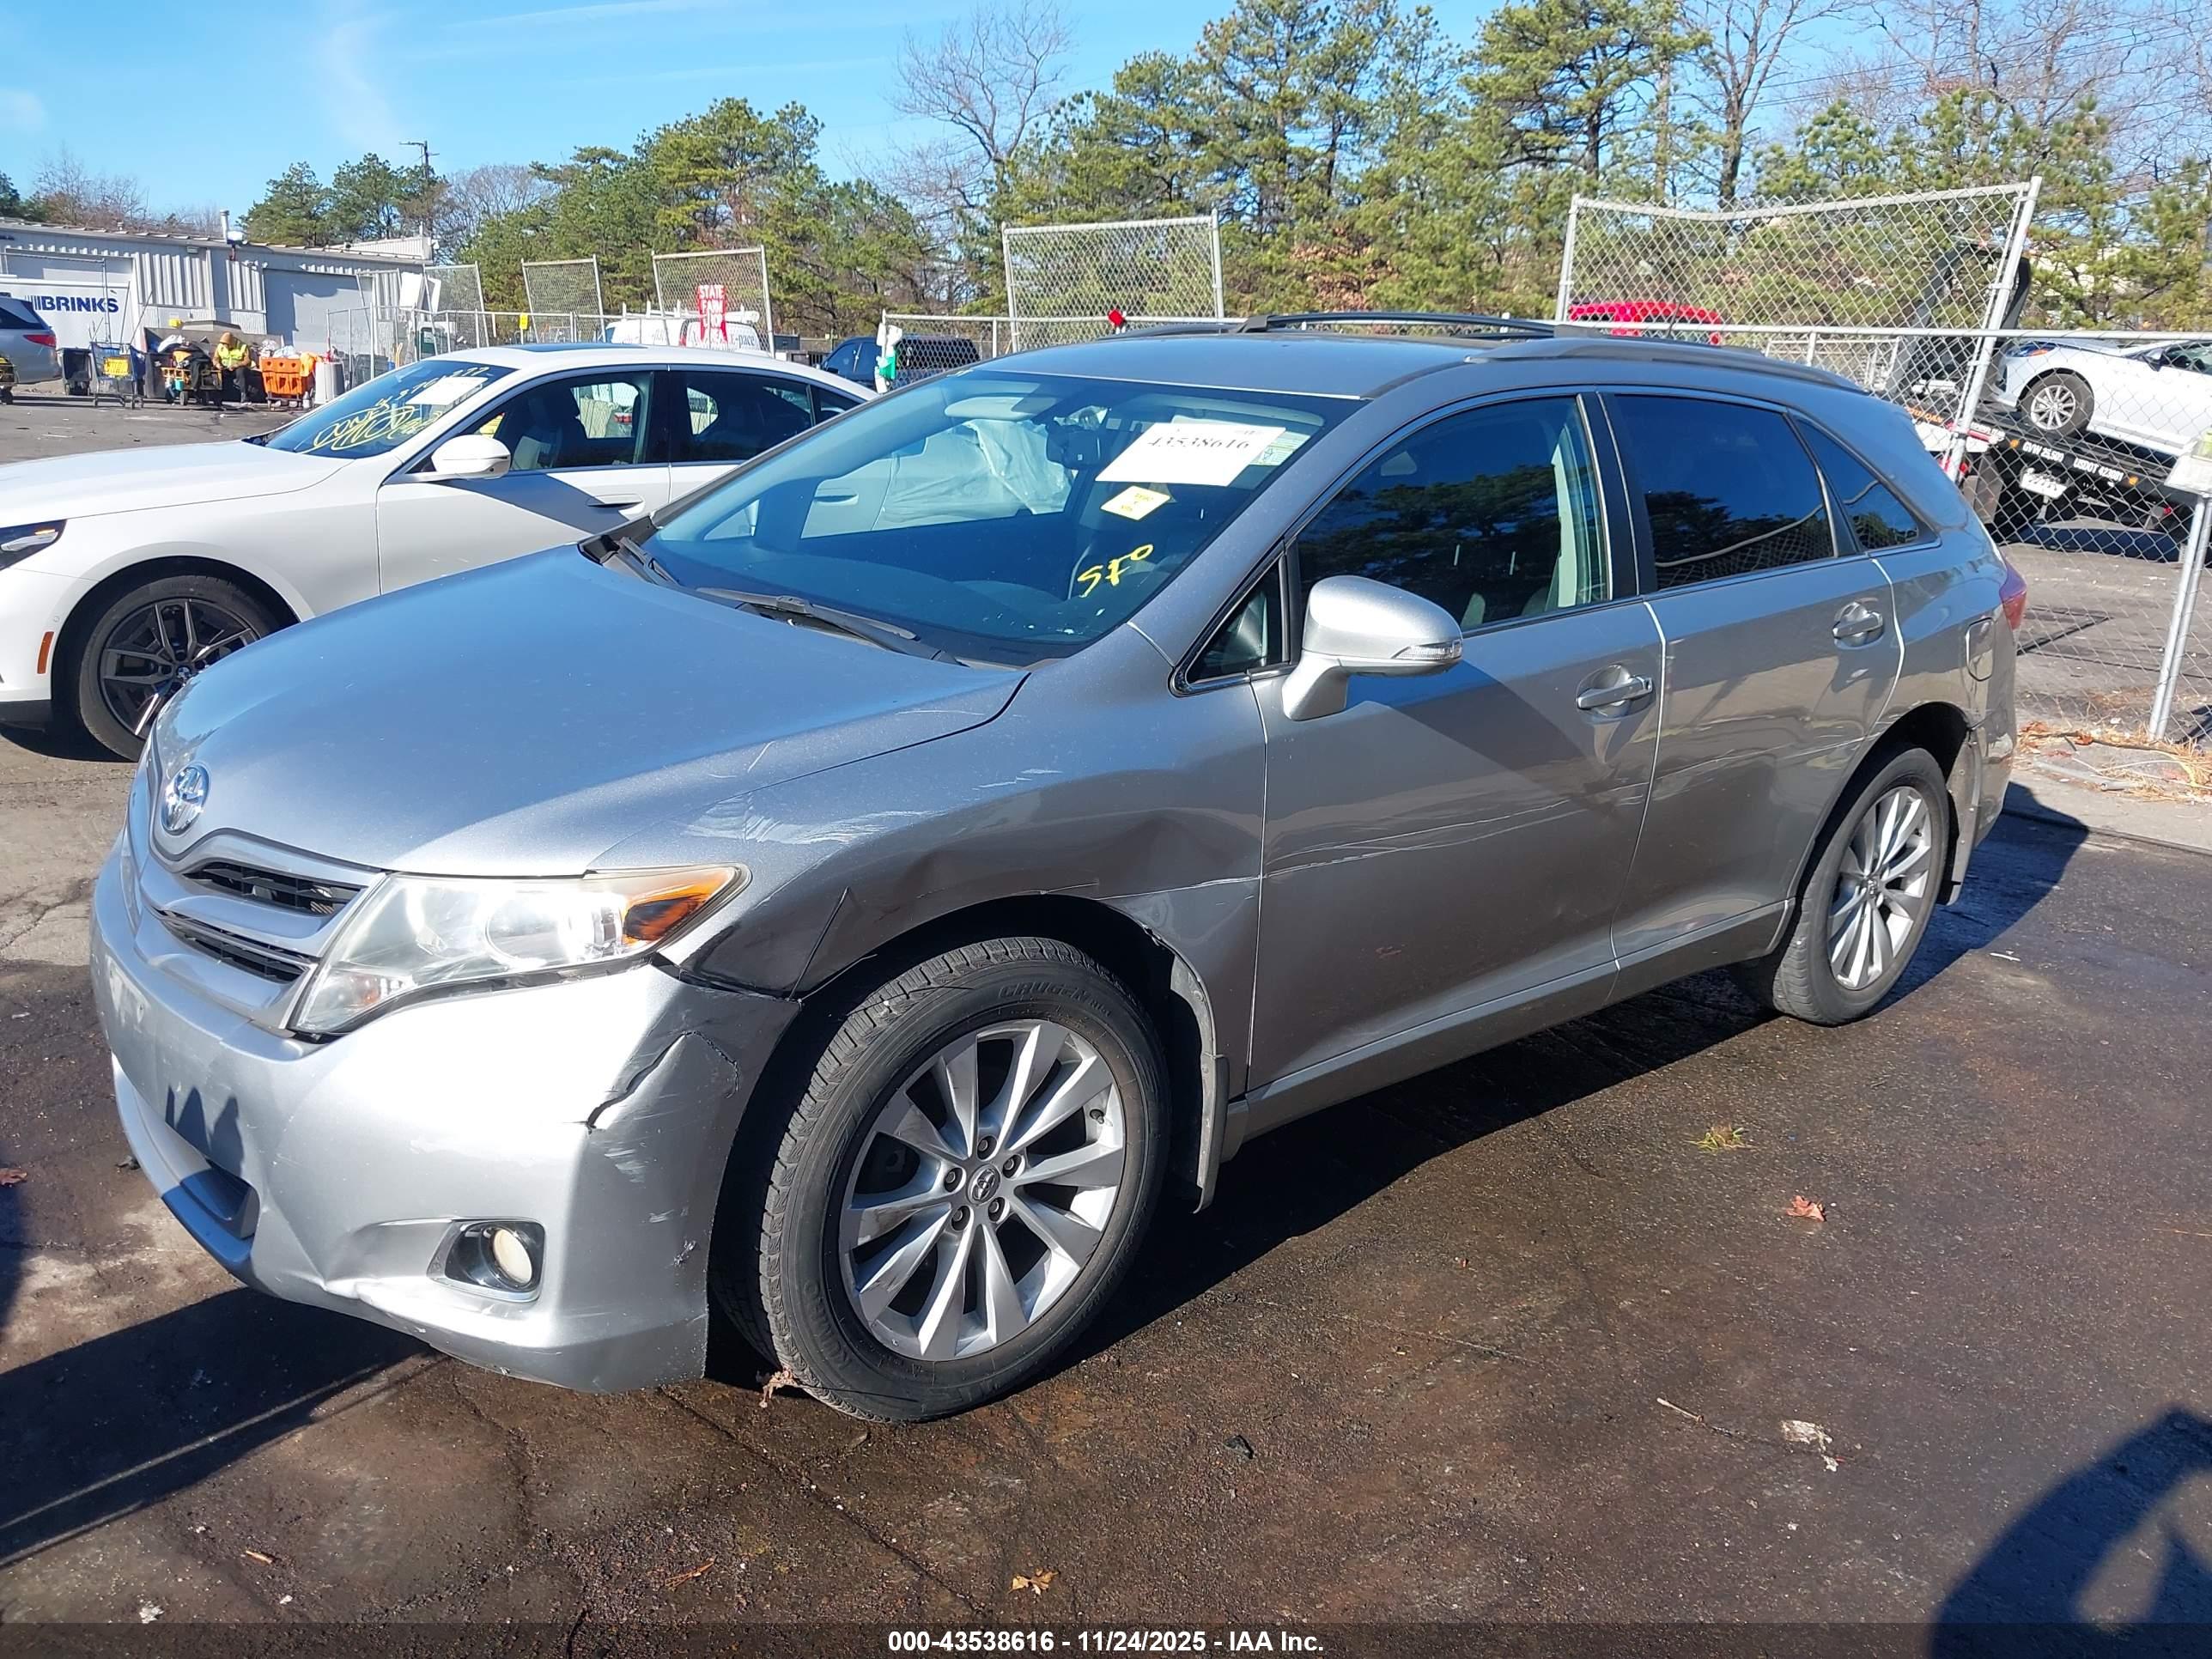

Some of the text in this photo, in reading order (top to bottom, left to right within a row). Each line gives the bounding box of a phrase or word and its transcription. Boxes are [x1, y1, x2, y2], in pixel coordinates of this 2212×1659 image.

[699, 285, 725, 299] STATE
[41, 295, 118, 313] BRINKS
[2022, 441, 2042, 456] GVW
[2073, 457, 2100, 473] USDOT
